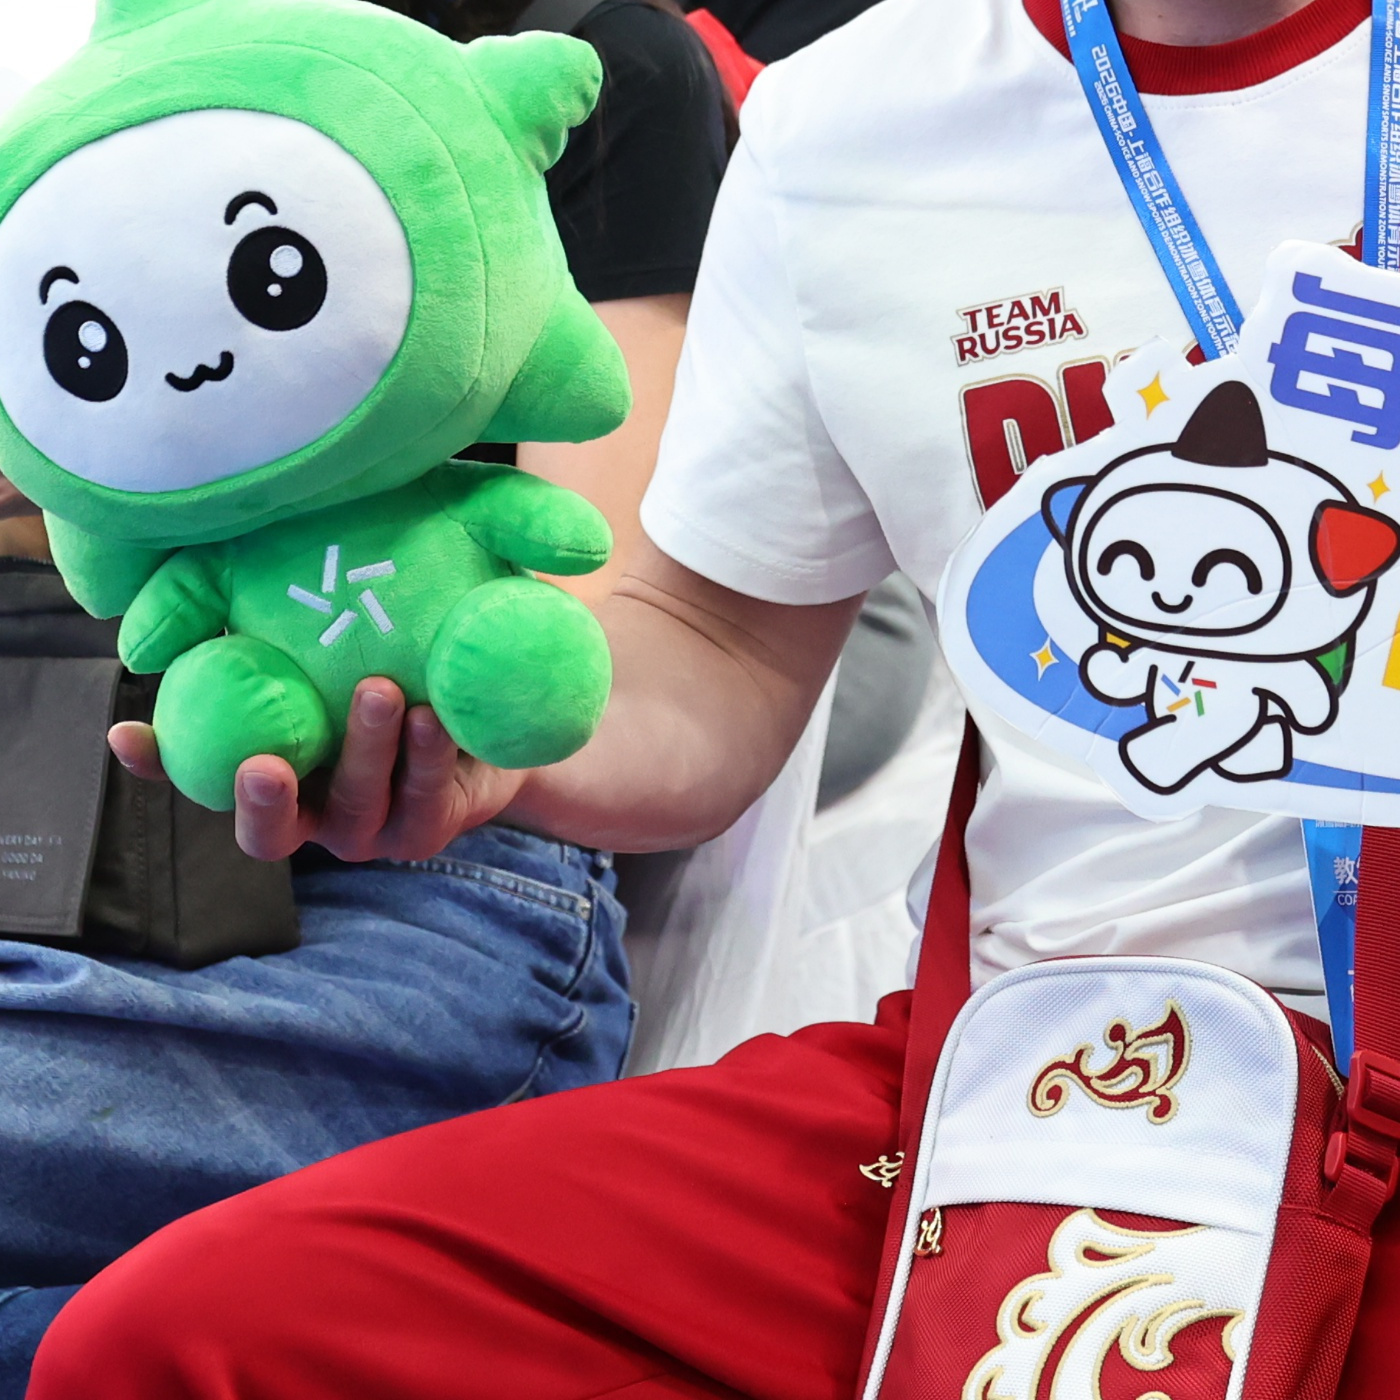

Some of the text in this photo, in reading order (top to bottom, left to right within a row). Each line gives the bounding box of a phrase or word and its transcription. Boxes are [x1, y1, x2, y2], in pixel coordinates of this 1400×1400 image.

[1383, 64, 1391, 83] AND
[1382, 84, 1391, 110] SNOW
[1380, 111, 1390, 141] SPORTS
[1378, 142, 1388, 218] DEMONSTRATION
[1094, 81, 1106, 106] 2026
[1121, 146, 1133, 162] ICE
[1127, 160, 1140, 179] AND
[1135, 177, 1152, 202] SNOW
[1147, 201, 1165, 232] SPORTS
[1161, 230, 1199, 299] DEMONSTRATION
[1193, 298, 1210, 324] ZONE
[1206, 321, 1225, 349] YOUTH
[1377, 219, 1386, 244] ZONE
[1377, 245, 1386, 269] YOUT
[963, 291, 1061, 333] TEAM
[956, 313, 1083, 361] RUSSIA
[1333, 856, 1360, 884] 教
